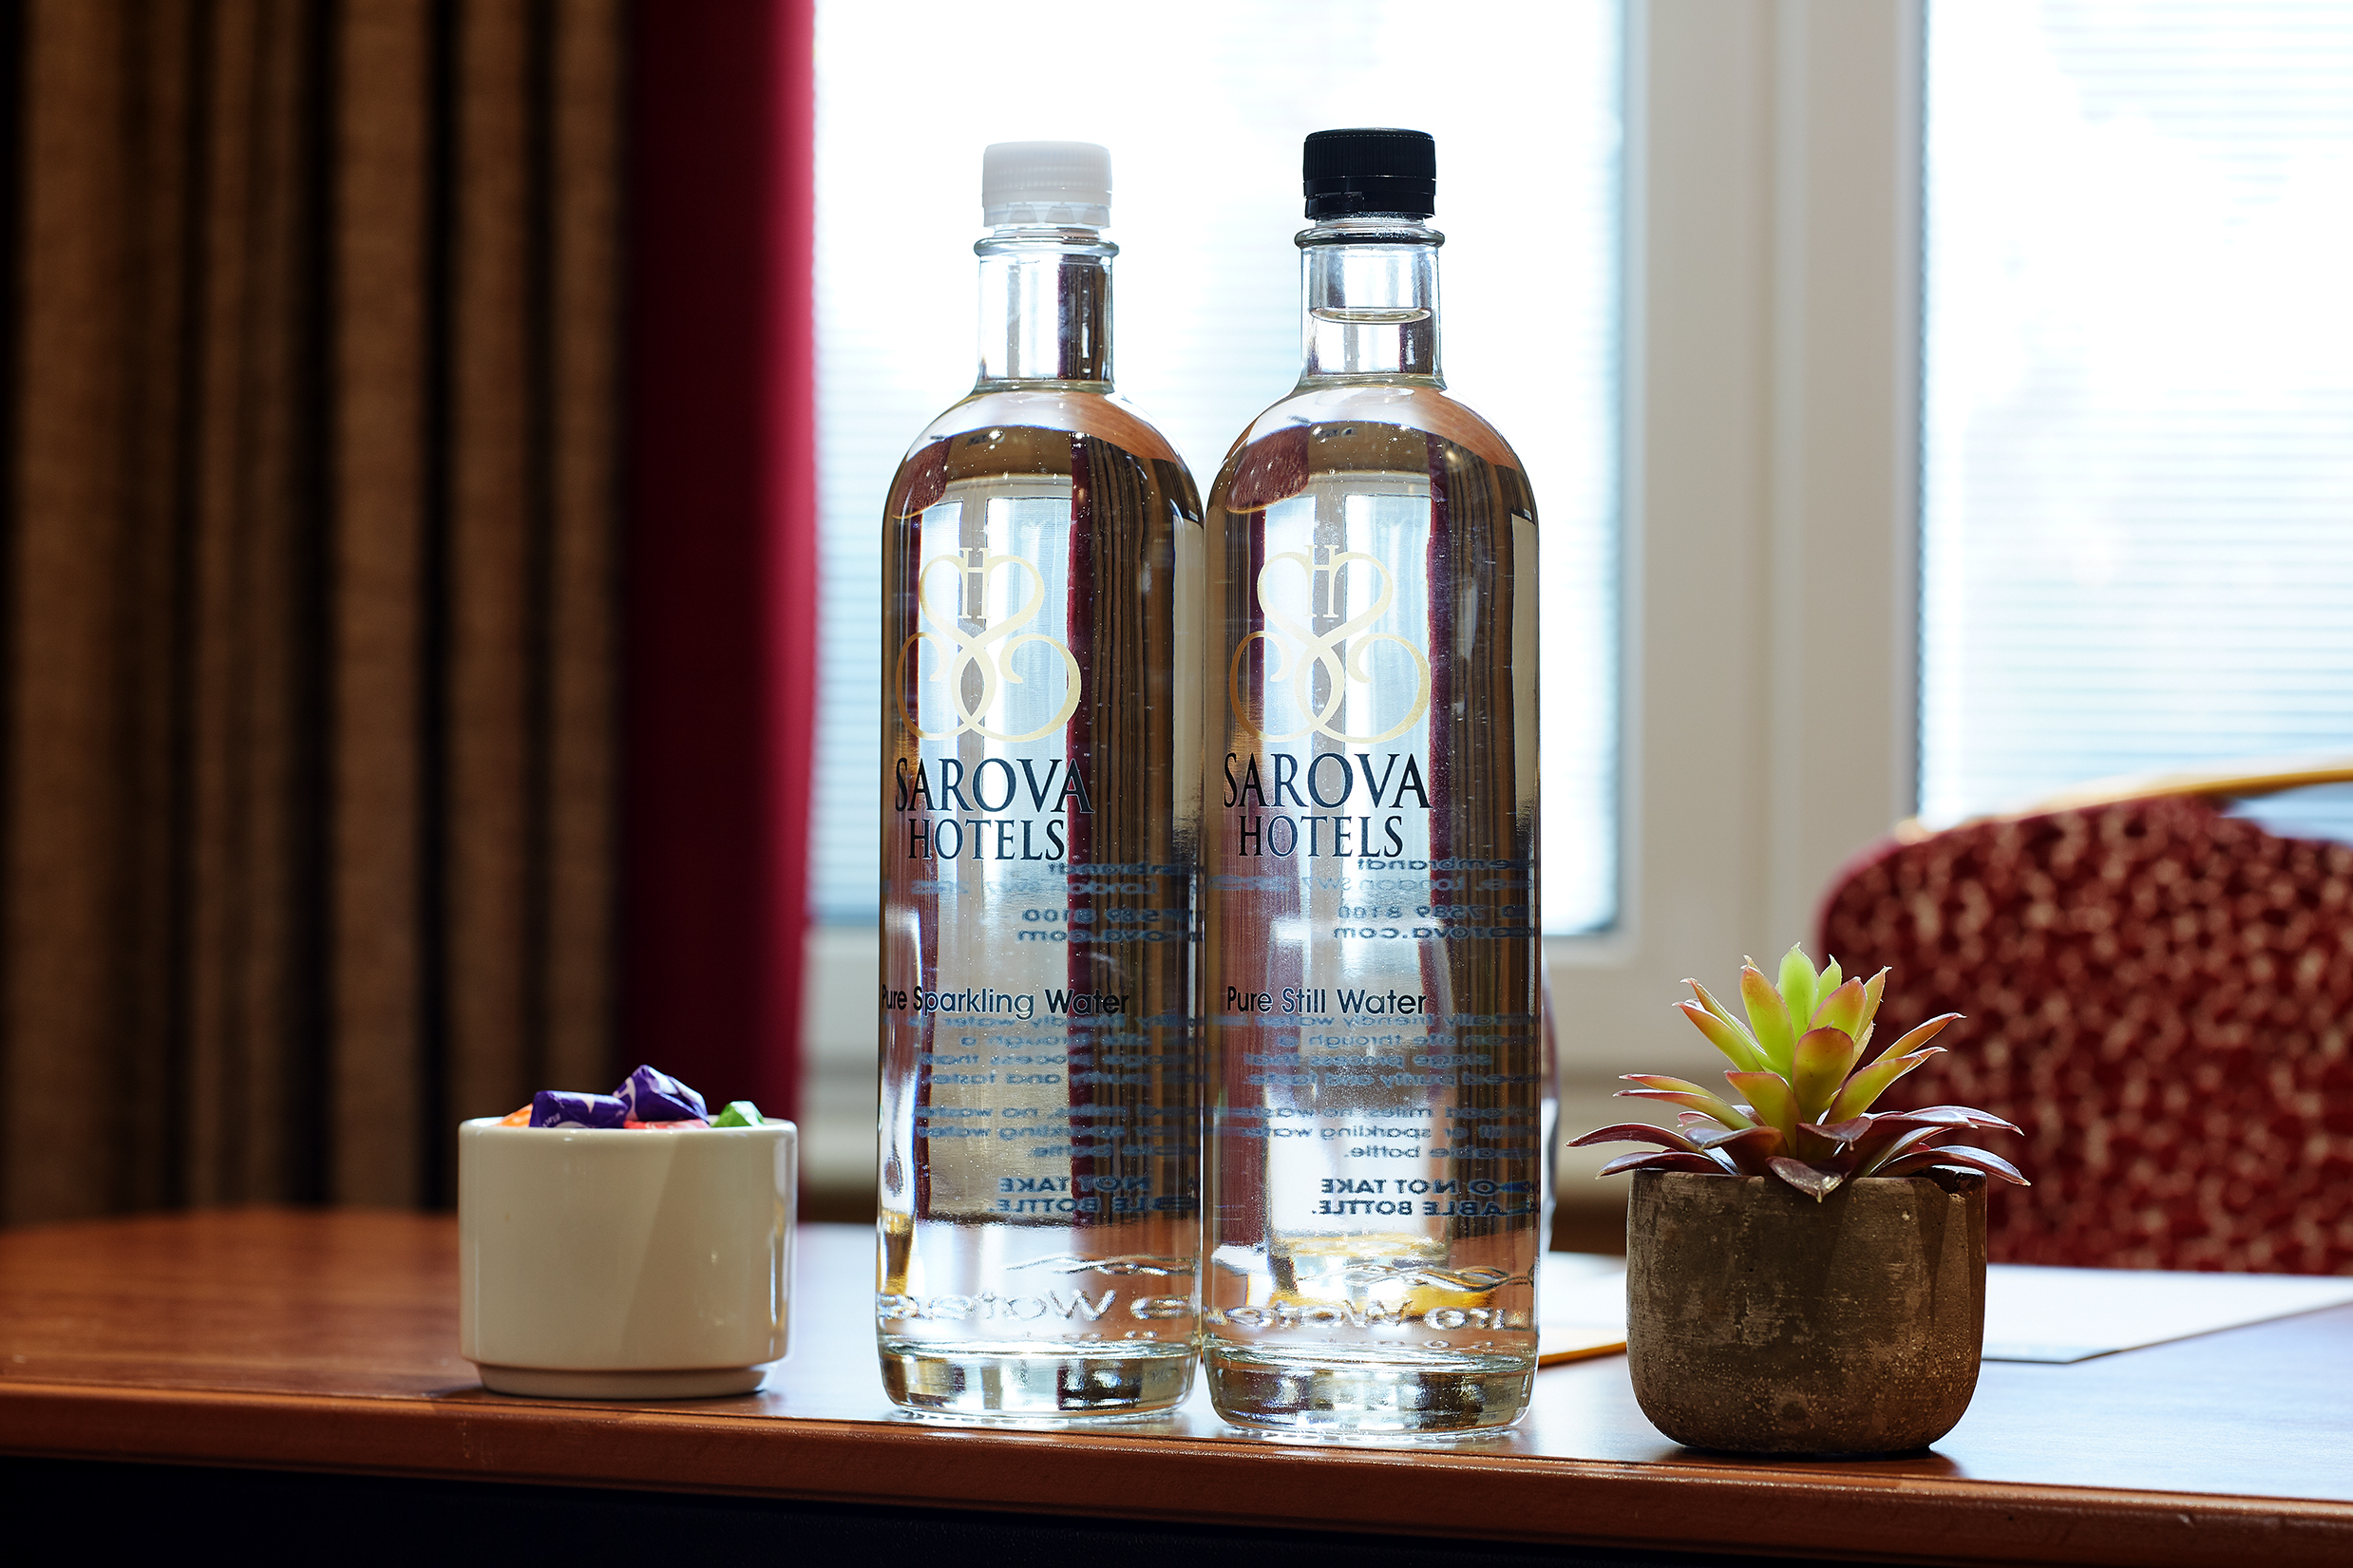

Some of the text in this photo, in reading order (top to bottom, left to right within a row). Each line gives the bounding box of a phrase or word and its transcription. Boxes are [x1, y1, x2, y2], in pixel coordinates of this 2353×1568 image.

[895, 757, 1095, 814] SAROVA
[1224, 752, 1433, 808] SAROVA
[908, 818, 1065, 861] HOTELS
[1239, 814, 1403, 857] HOTELS
[882, 985, 1129, 1020] Pure Sparkling Water
[1227, 986, 1428, 1014] Pure Still Water
